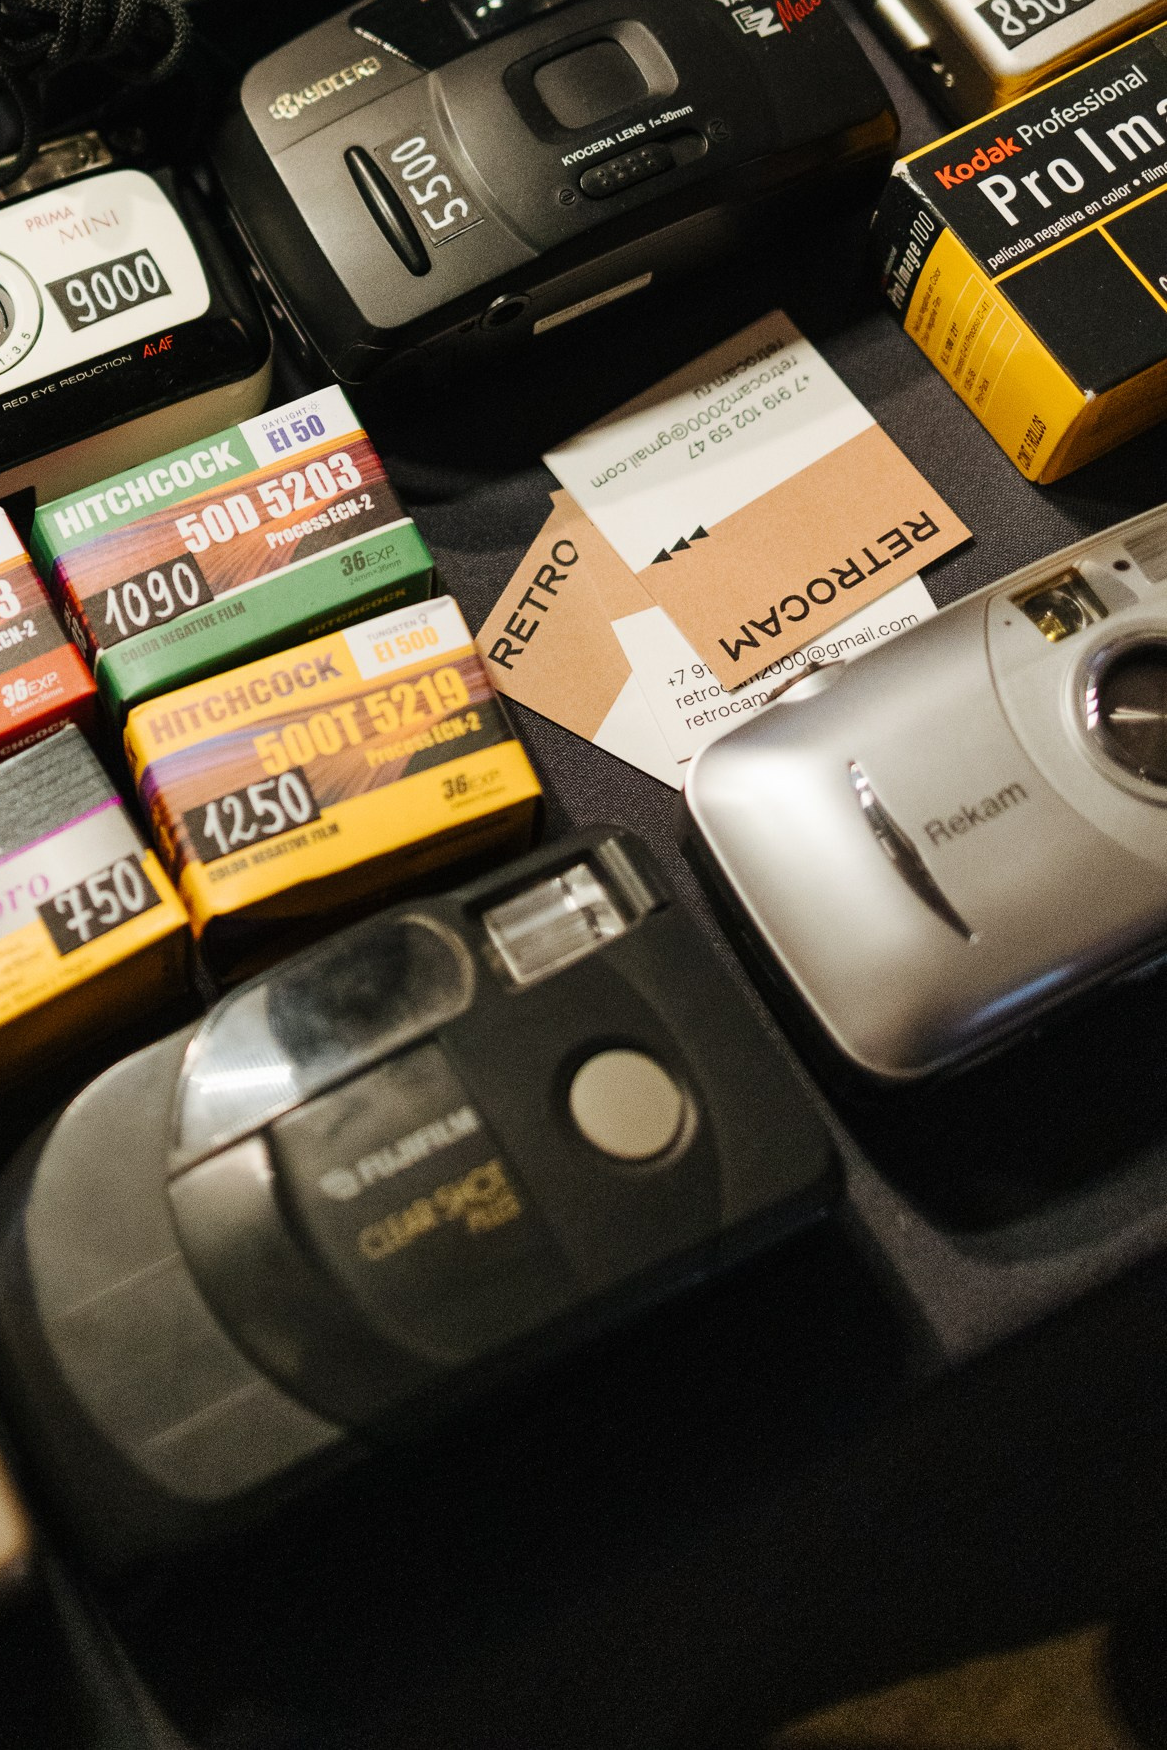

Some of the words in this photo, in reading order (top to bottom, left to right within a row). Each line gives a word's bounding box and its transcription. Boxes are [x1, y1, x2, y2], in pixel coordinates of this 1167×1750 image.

[561, 137, 616, 168] KYOCERA
[615, 123, 646, 145] LENS
[648, 105, 693, 130] f=30mm
[934, 135, 1022, 190] Kodak
[1016, 64, 1148, 146] Professional
[390, 135, 471, 232] 5500
[977, 157, 1085, 227] Pro
[25, 206, 75, 233] PRIMA
[58, 209, 120, 246] MINI
[987, 235, 1035, 271] película
[1033, 210, 1086, 244] negativa
[1084, 199, 1102, 217] en
[1101, 182, 1132, 208] color
[65, 254, 161, 323] 9000
[2, 395, 29, 411] RED
[31, 383, 57, 400] EYE
[59, 354, 132, 388] REDUCTION
[764, 386, 793, 412] 919
[793, 373, 811, 394] +7
[261, 406, 309, 432] DAYLIGHT
[290, 413, 327, 446] 50
[590, 353, 799, 489] retrocam2000@gmail.com
[688, 439, 707, 460] 47
[708, 424, 734, 445] 59
[734, 405, 763, 430] 102
[52, 440, 242, 539] HITCHCOCK
[176, 493, 261, 554] 50D
[257, 451, 363, 518] 5203
[264, 514, 332, 551] Process
[329, 493, 376, 525] ECN-2
[103, 561, 200, 636] 1090
[487, 539, 579, 671] RETRO
[718, 510, 941, 663] RETROCAM
[119, 636, 159, 666] COLOR
[159, 612, 216, 650] NEGATIVE
[215, 600, 247, 628] FILM
[366, 618, 418, 643] TUNGSTEN
[393, 625, 441, 658] 500
[147, 651, 344, 745] HITCHCOCK
[667, 668, 685, 688] +7
[251, 700, 365, 776] 500T
[362, 666, 472, 734] 5219
[684, 691, 770, 730] retrocam
[203, 770, 311, 856] 1250
[250, 834, 311, 868] NEGATIVE
[311, 822, 341, 845] FILM
[922, 781, 1029, 847] Rekam
[53, 861, 146, 943] 750
